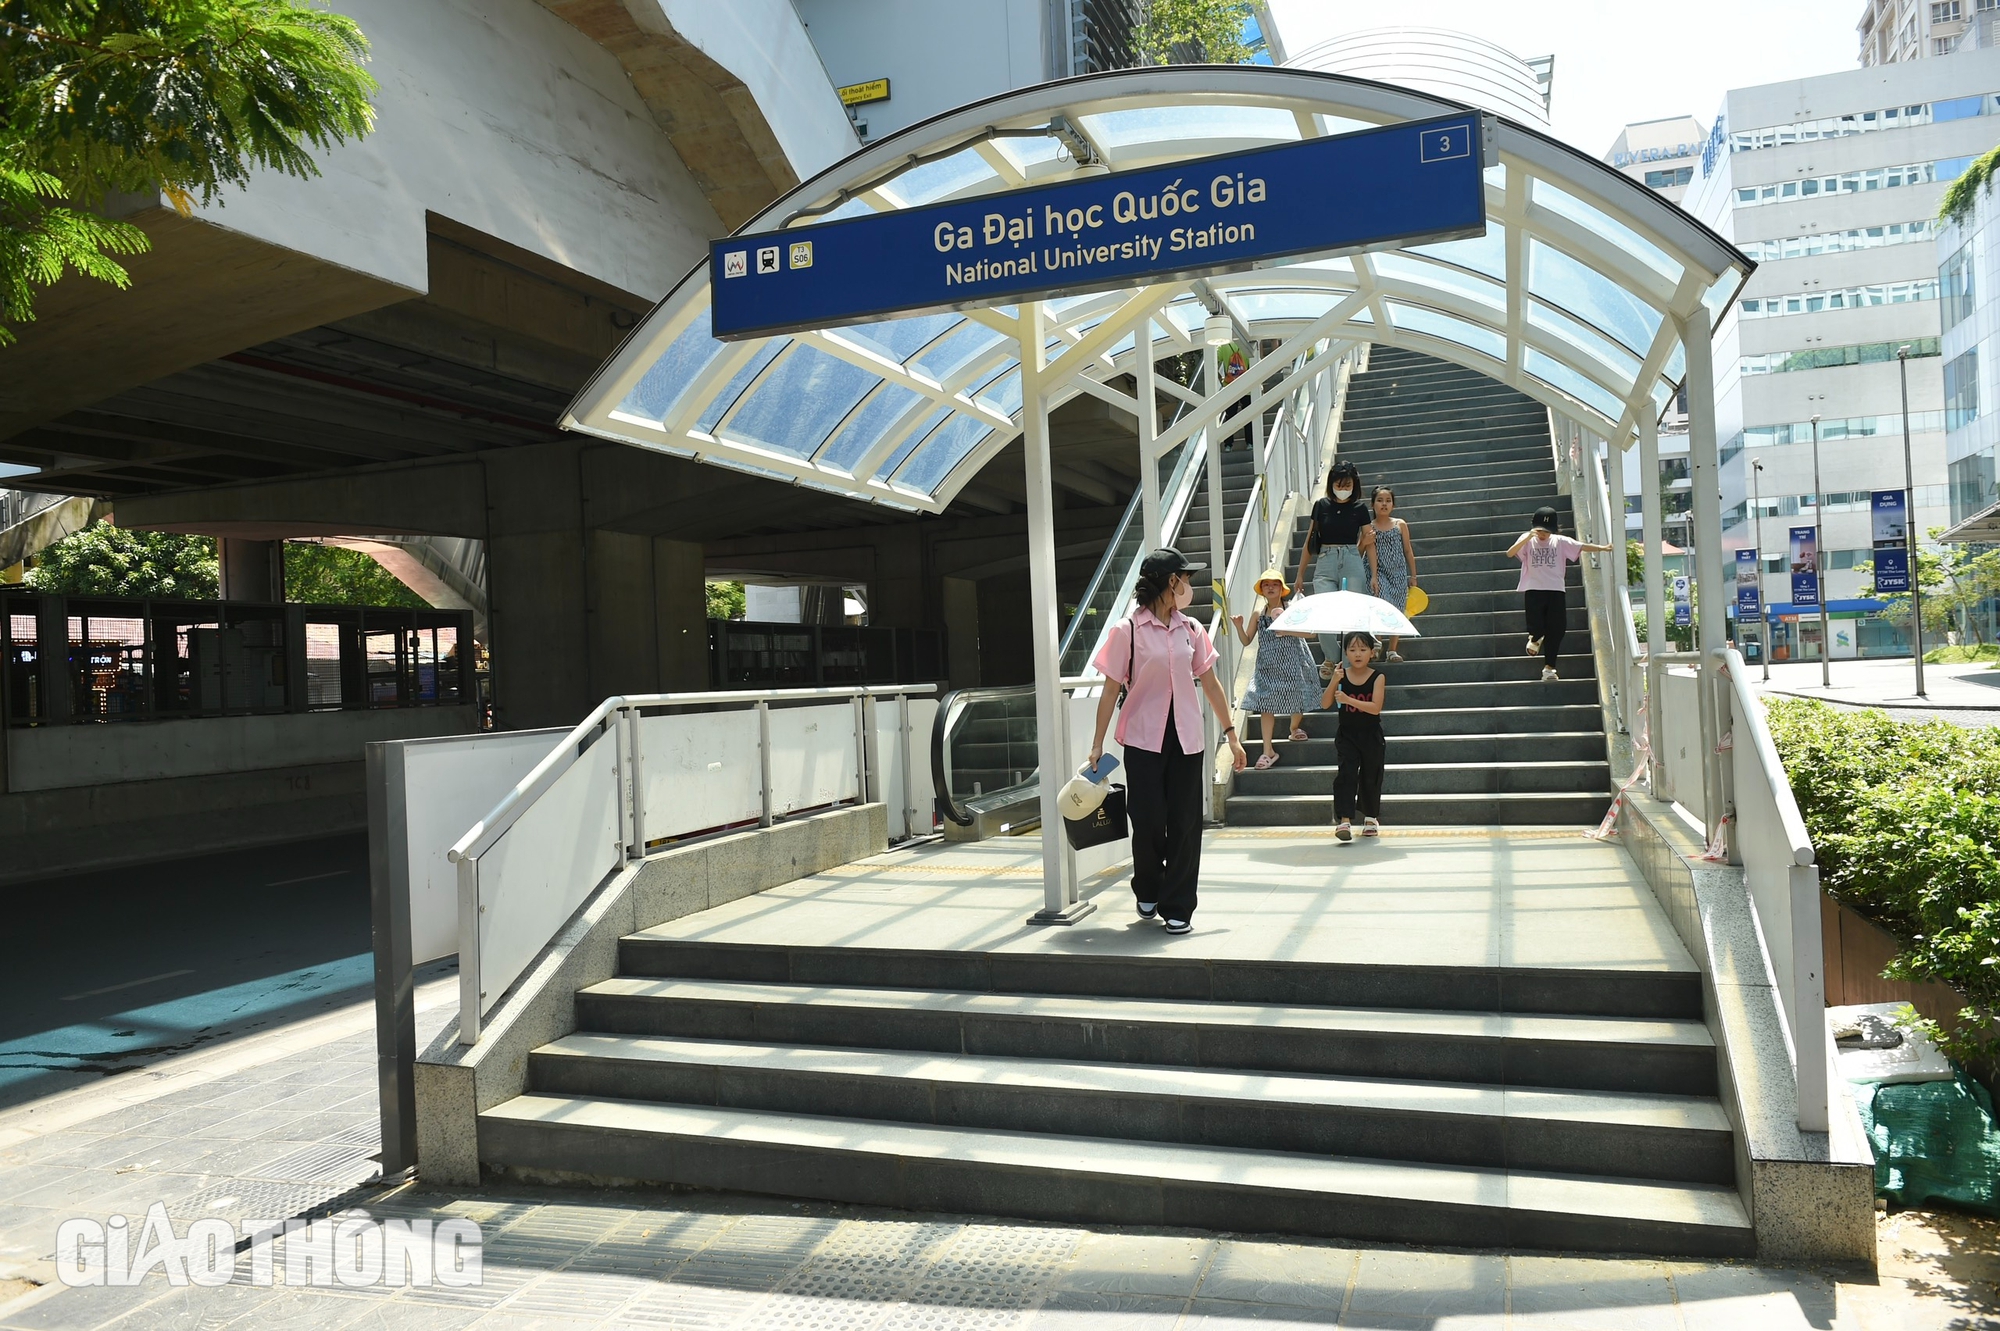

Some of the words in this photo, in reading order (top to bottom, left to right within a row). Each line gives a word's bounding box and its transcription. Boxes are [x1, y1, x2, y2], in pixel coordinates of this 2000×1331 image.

[1440, 136, 1450, 152] 3
[1614, 147, 1672, 166] RIVERA
[934, 222, 973, 253] Ga
[983, 208, 1033, 249] Đại
[1046, 204, 1104, 238] học
[1114, 178, 1201, 225] Quốc
[1211, 173, 1266, 208] Gia
[797, 246, 805, 254] T3
[946, 252, 1038, 286] National
[1045, 234, 1163, 270] University
[1170, 222, 1256, 252] Station
[794, 254, 809, 264] S06
[1883, 576, 1905, 586] JYSK
